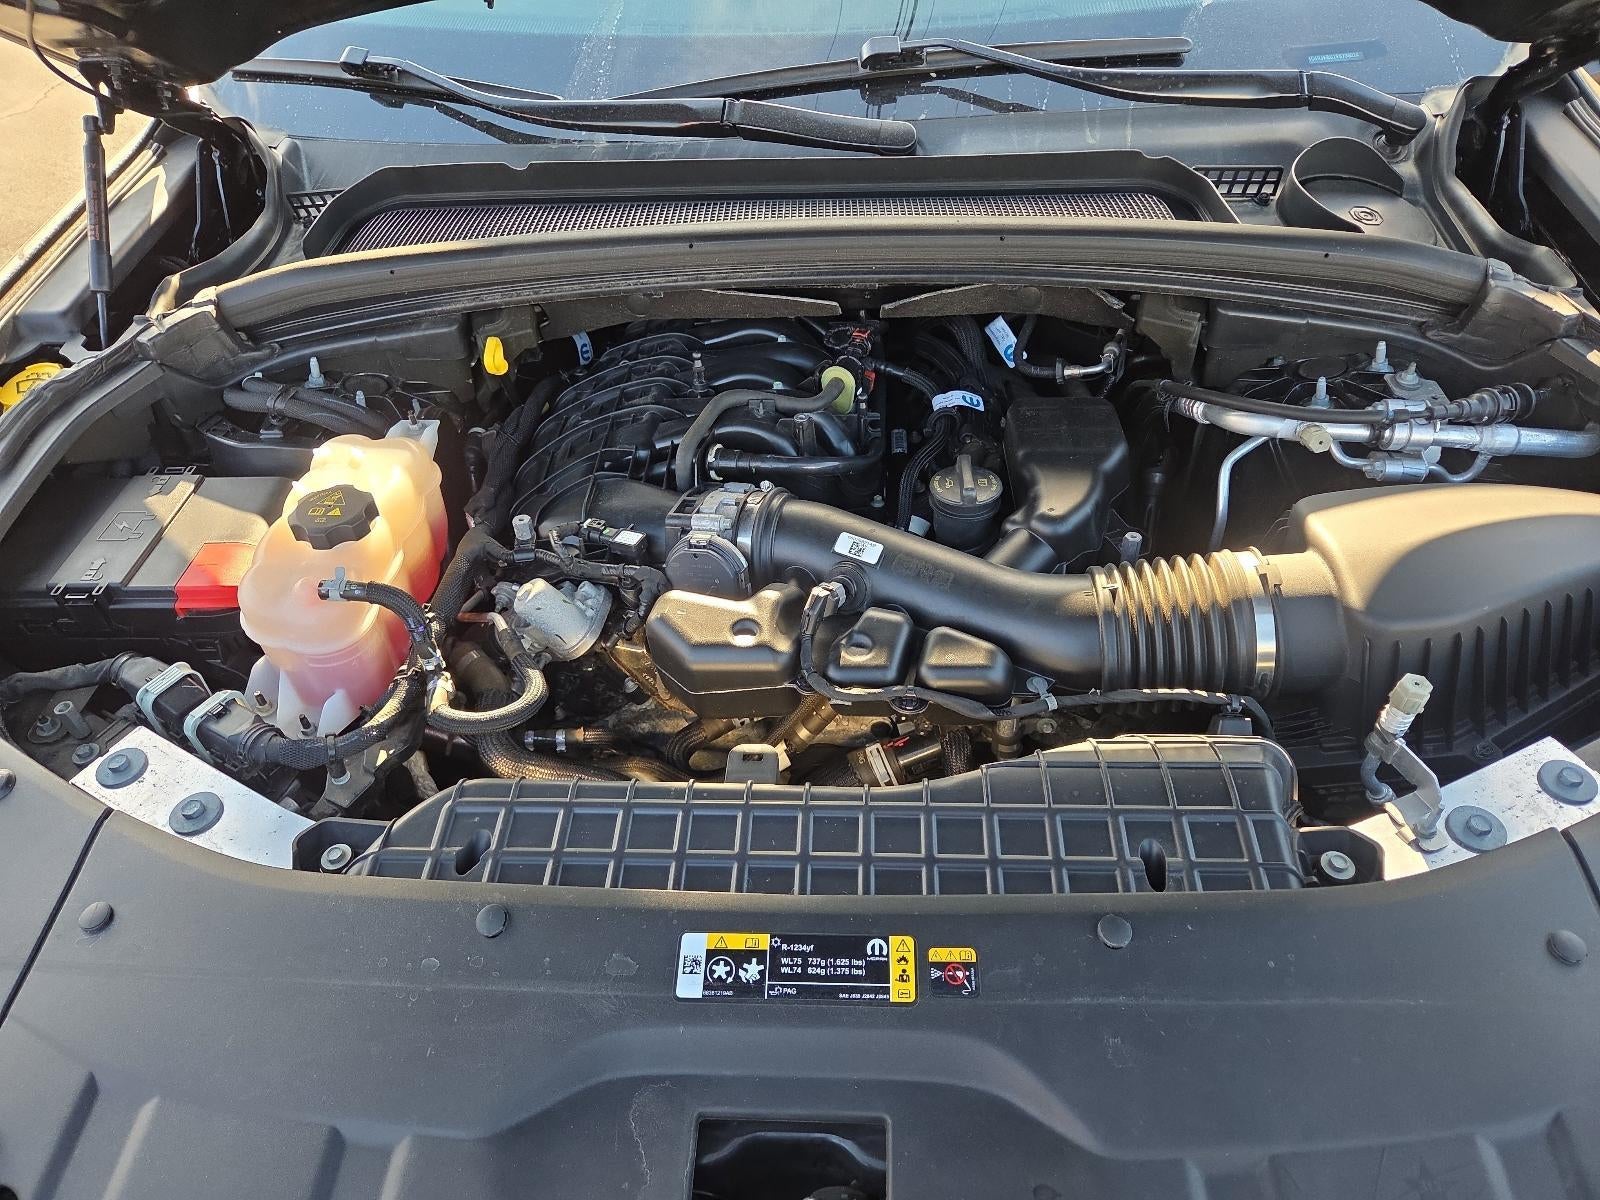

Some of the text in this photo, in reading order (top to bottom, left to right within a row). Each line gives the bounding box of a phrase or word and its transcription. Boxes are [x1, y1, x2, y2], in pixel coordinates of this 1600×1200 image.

[781, 943, 815, 953] R-1234yf
[780, 957, 866, 968] WL75 737g (1.625 lbs)
[780, 966, 866, 977] WL74 624g (1.375 lbs)
[782, 987, 797, 995] PAG
